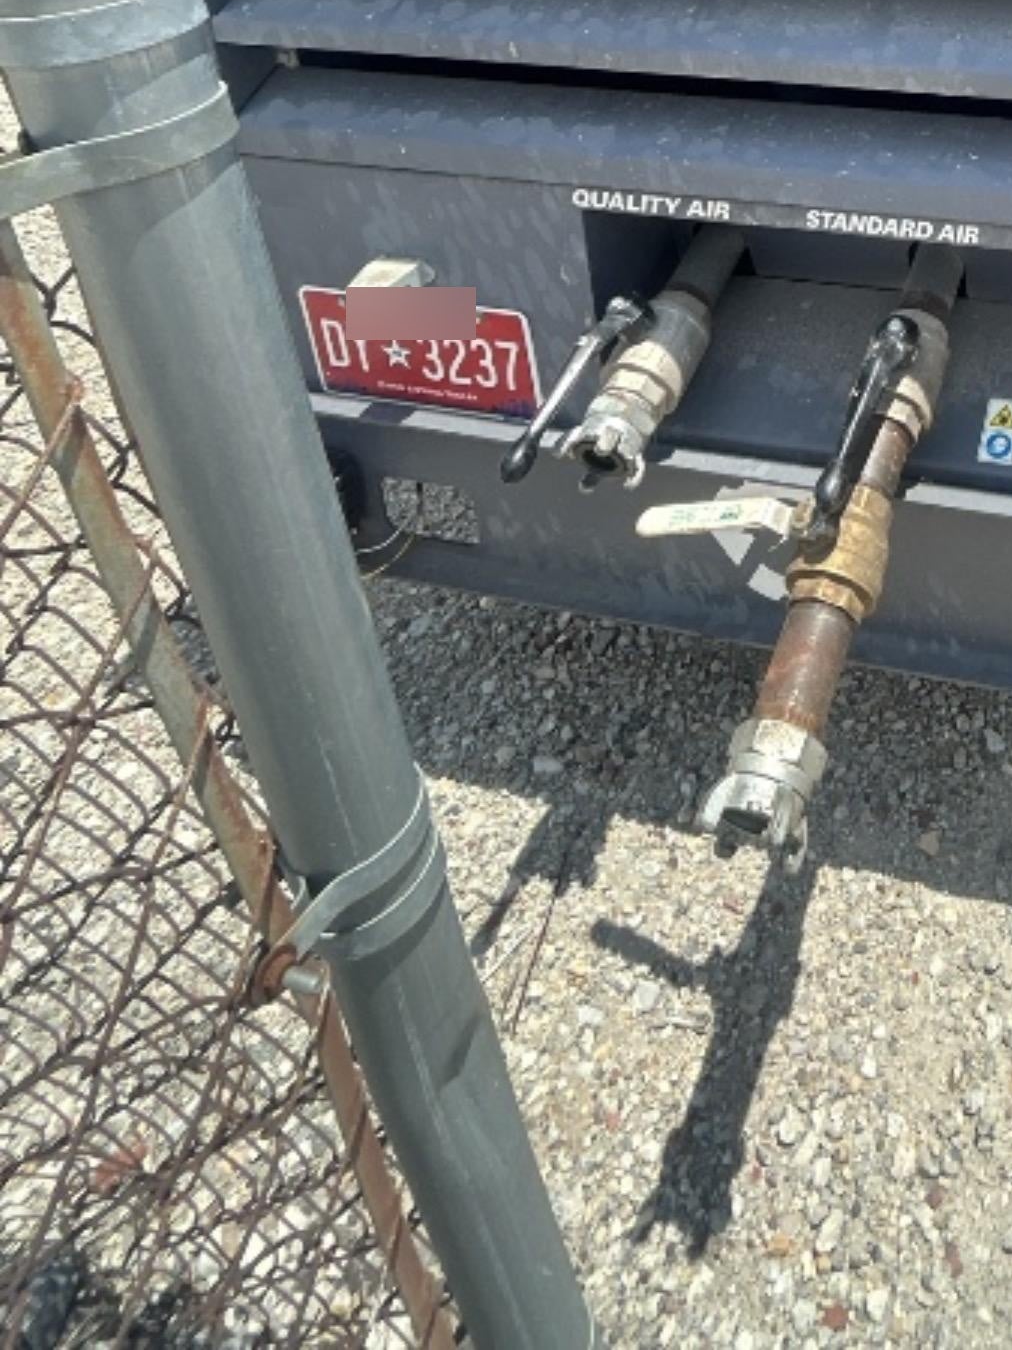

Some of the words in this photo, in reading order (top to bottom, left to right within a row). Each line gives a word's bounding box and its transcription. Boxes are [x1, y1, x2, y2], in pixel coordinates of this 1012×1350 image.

[572, 188, 682, 217] QUALITY
[686, 200, 731, 220] AIR
[805, 209, 934, 241] STANDARD
[938, 223, 981, 245] AIR
